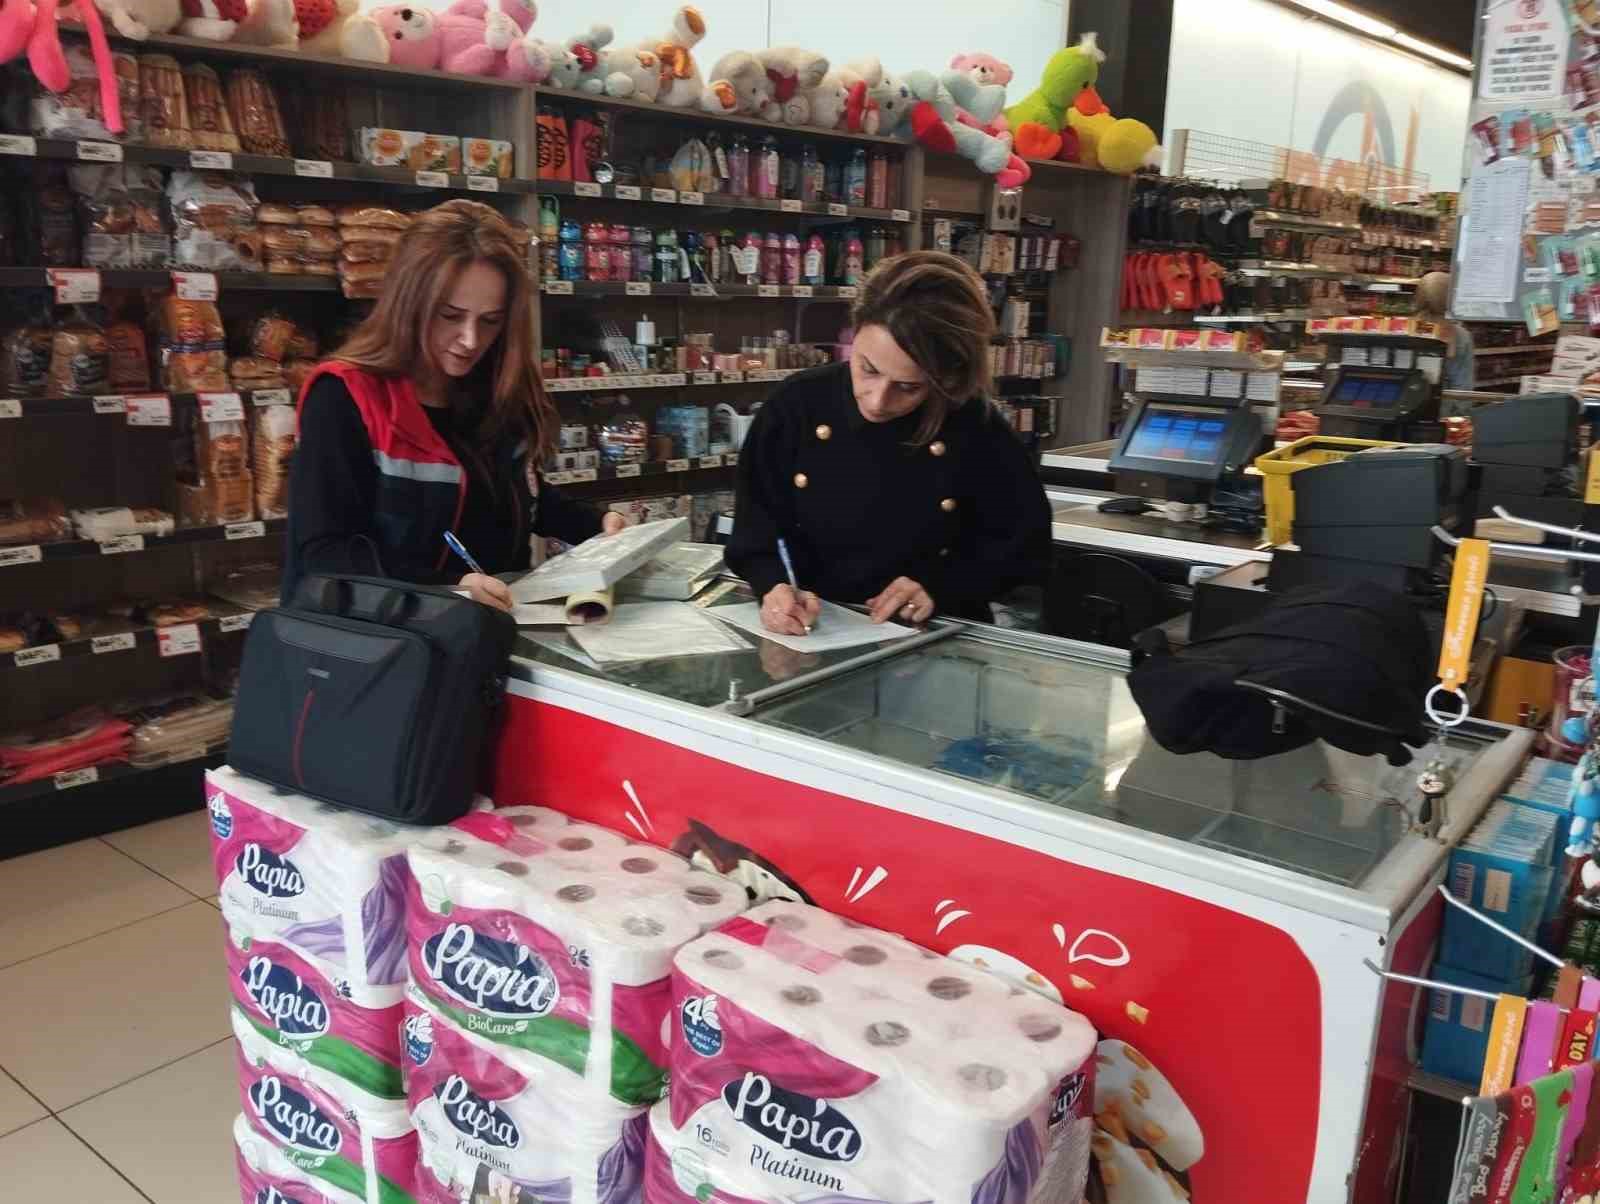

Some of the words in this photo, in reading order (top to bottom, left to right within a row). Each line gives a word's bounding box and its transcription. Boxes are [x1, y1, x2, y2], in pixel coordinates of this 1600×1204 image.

[241, 843, 305, 897] Papia
[432, 922, 552, 1012] Papia
[248, 956, 326, 1032] Papia
[467, 1015, 516, 1035] BioCare
[1568, 1031, 1588, 1061] DAY
[257, 1075, 337, 1150] Papia
[438, 1074, 517, 1148] Papia
[696, 1123, 712, 1143] 16
[734, 1071, 857, 1161] Papia
[455, 1134, 513, 1174] Platinum
[750, 1144, 844, 1192] Platinum
[1470, 1164, 1491, 1197] Bad
